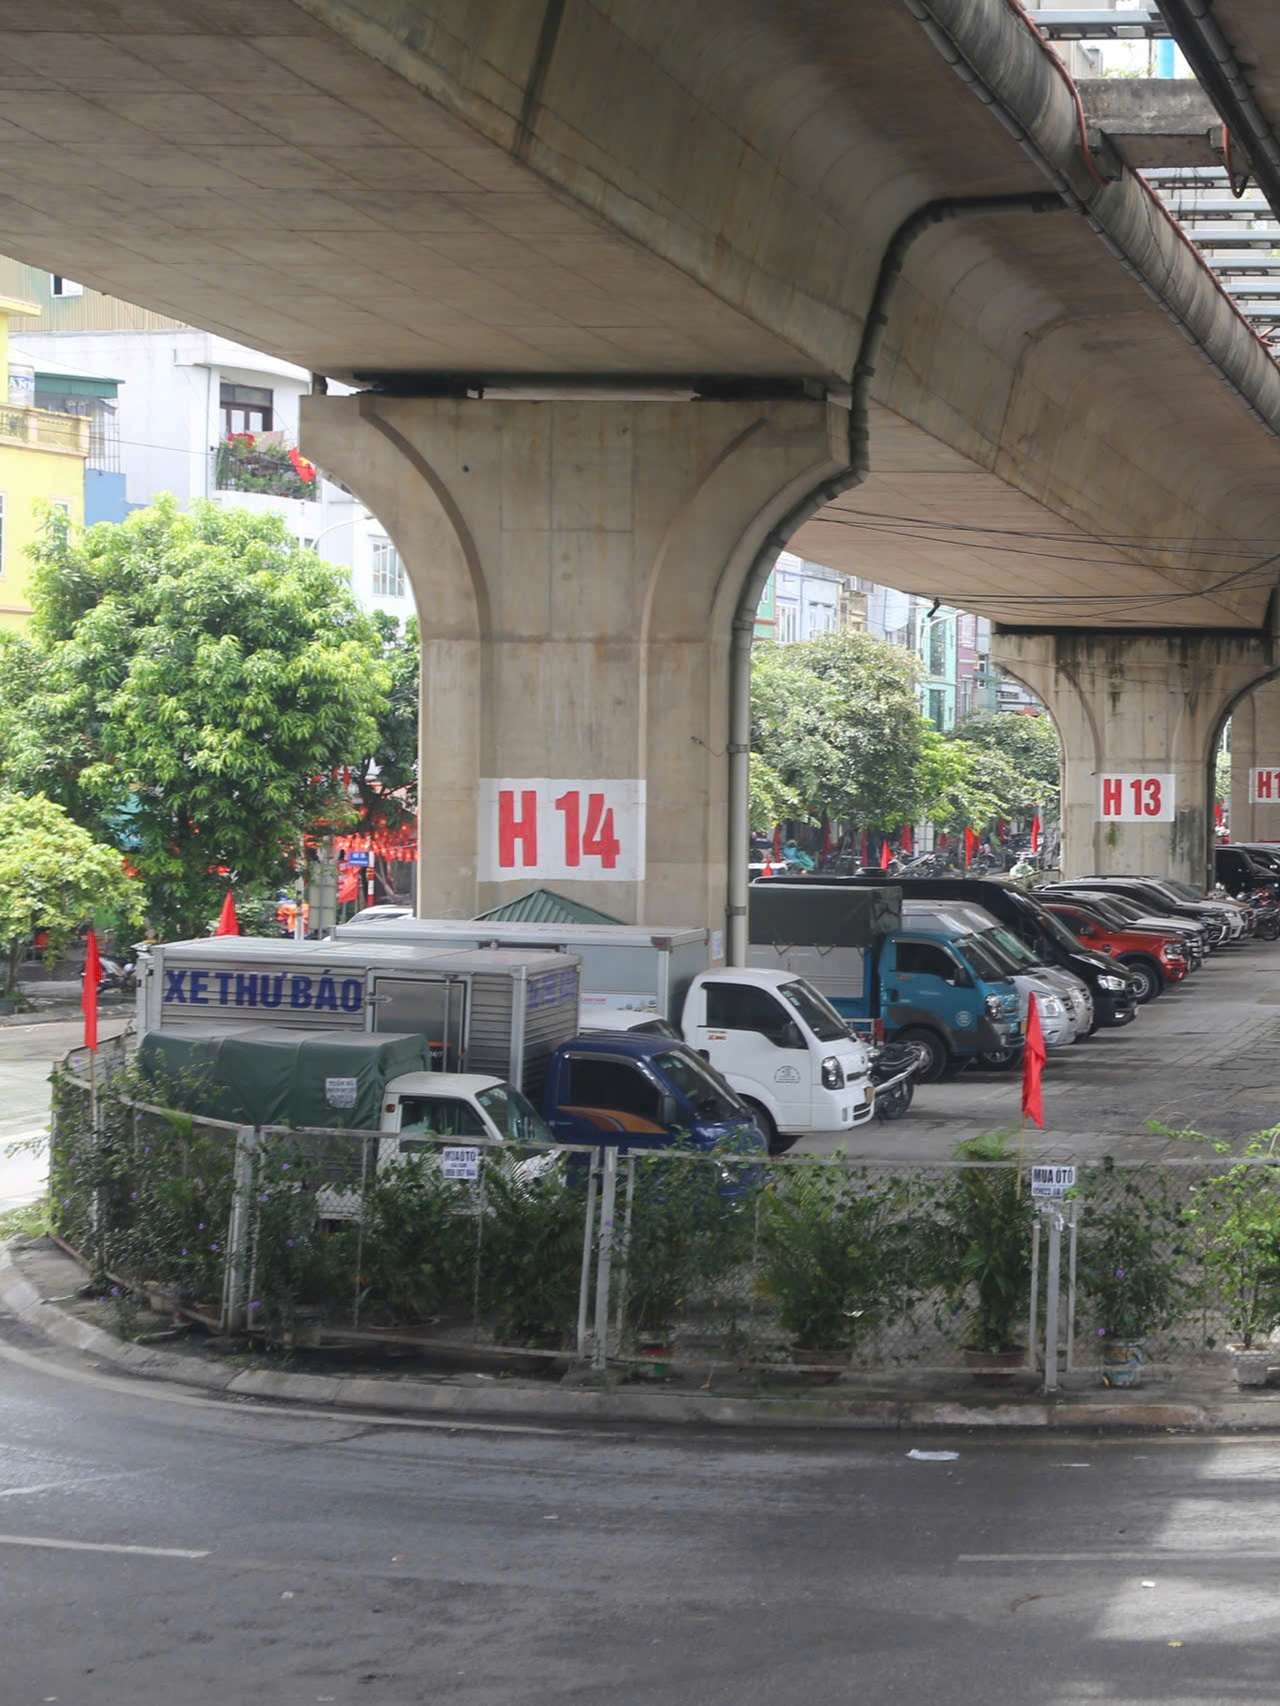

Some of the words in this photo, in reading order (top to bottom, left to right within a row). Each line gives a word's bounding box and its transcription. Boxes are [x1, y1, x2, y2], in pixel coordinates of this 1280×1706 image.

[498, 789, 538, 868] H
[555, 790, 621, 869] 14
[165, 969, 209, 1004] XE
[290, 968, 363, 1013] BÁO
[1034, 1168, 1053, 1183] MUA
